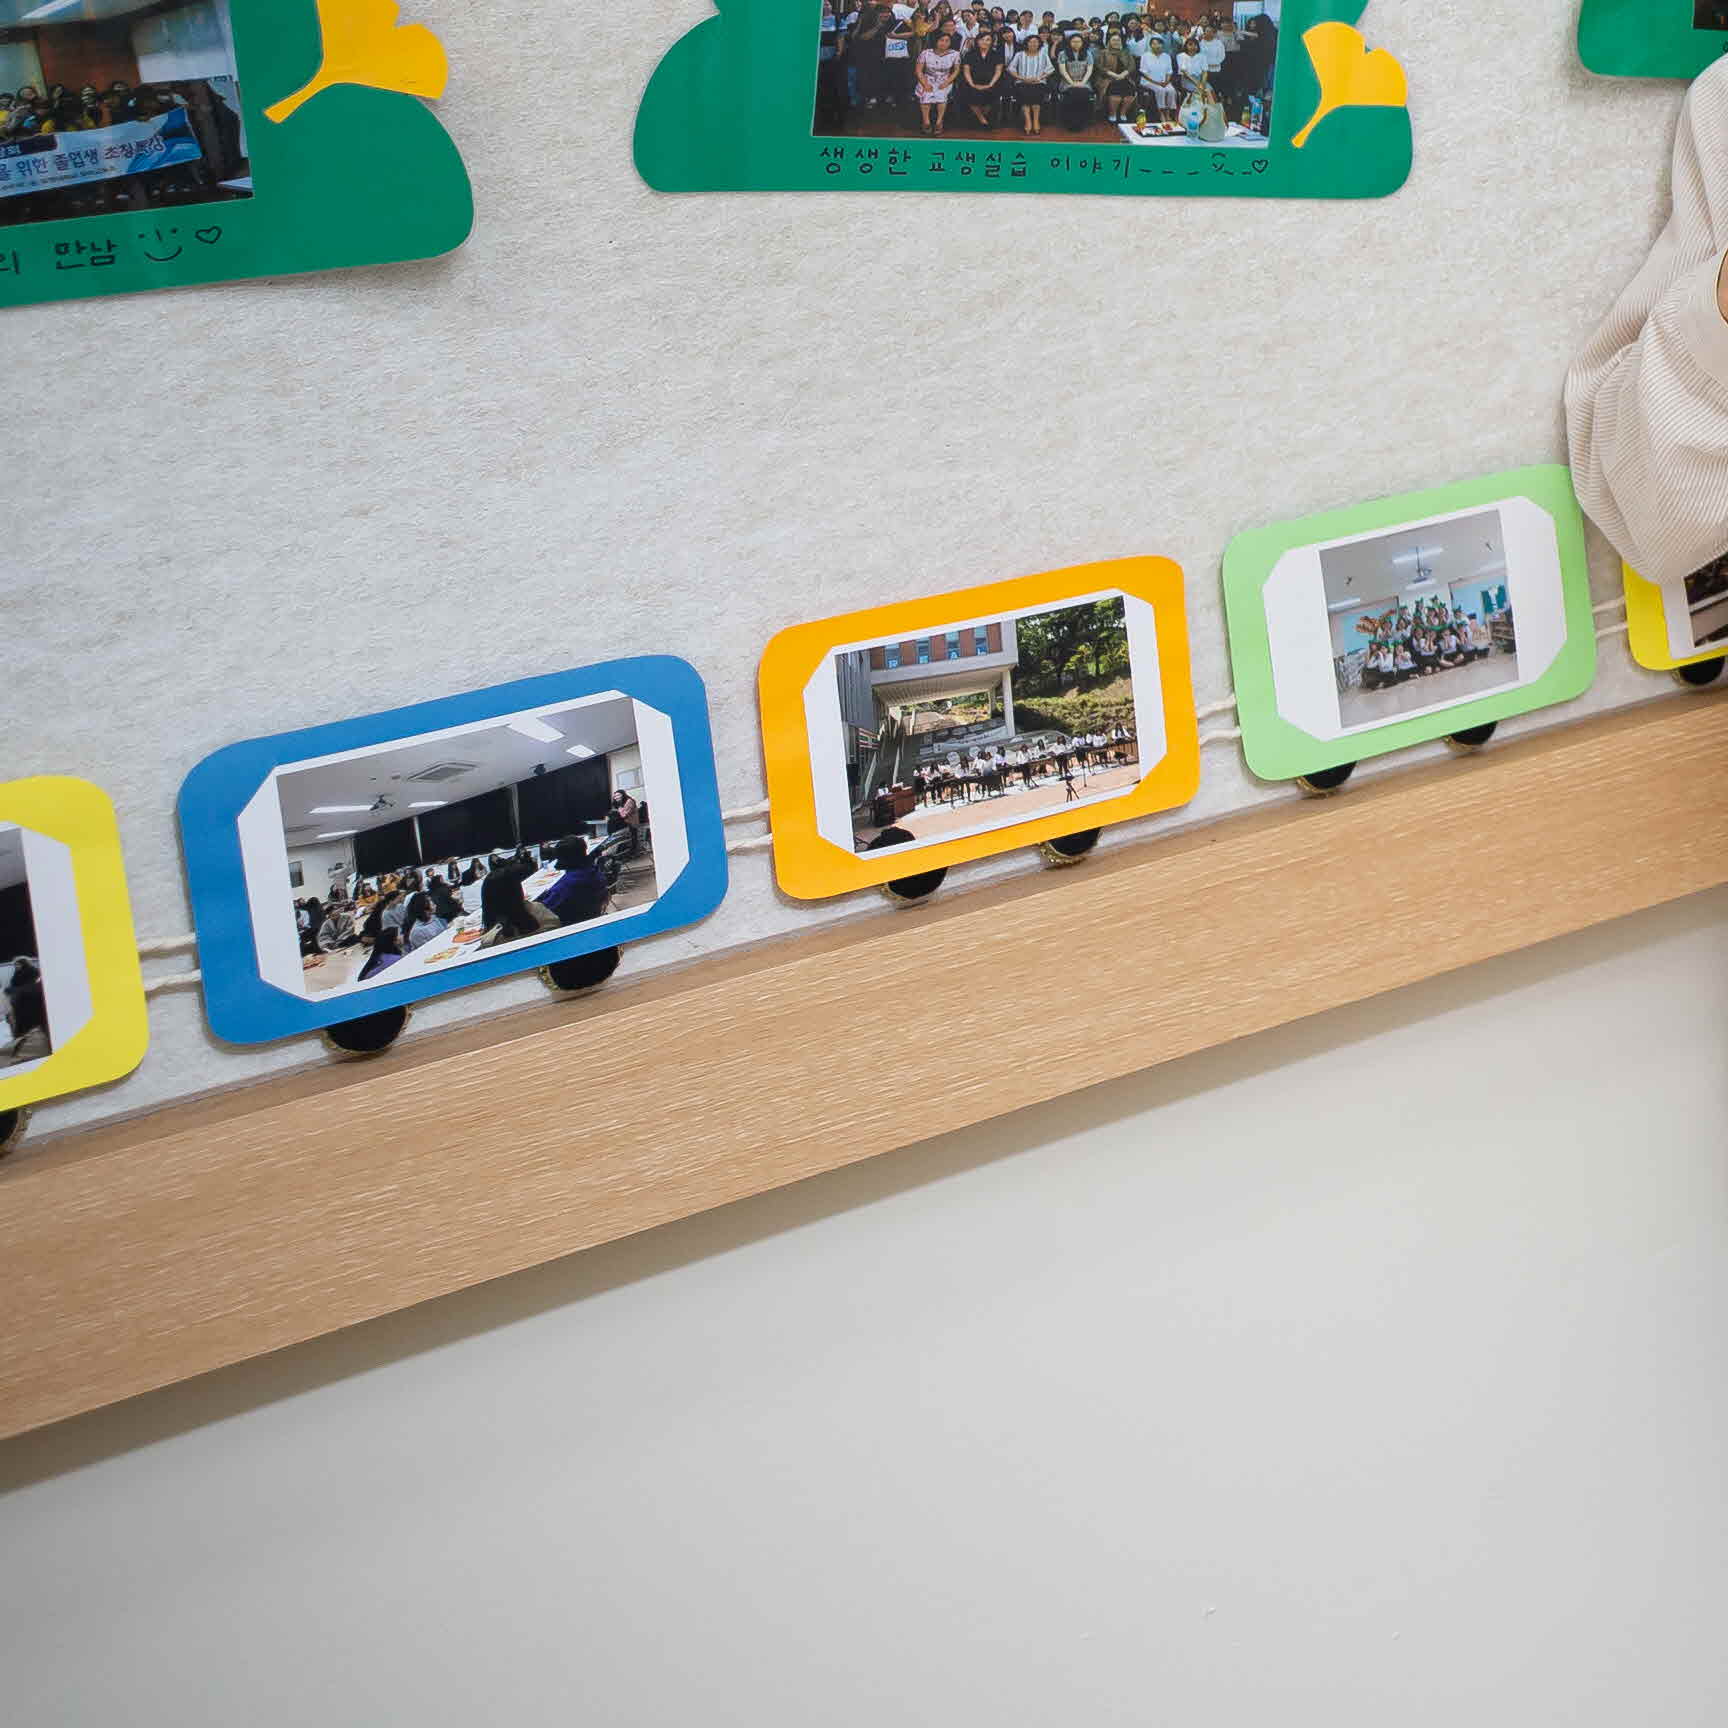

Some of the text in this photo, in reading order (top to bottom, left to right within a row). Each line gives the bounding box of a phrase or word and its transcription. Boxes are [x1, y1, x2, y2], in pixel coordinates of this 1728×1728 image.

[818, 145, 1131, 179] 생생한 교생실습 이야기
[54, 239, 119, 270] 만남
